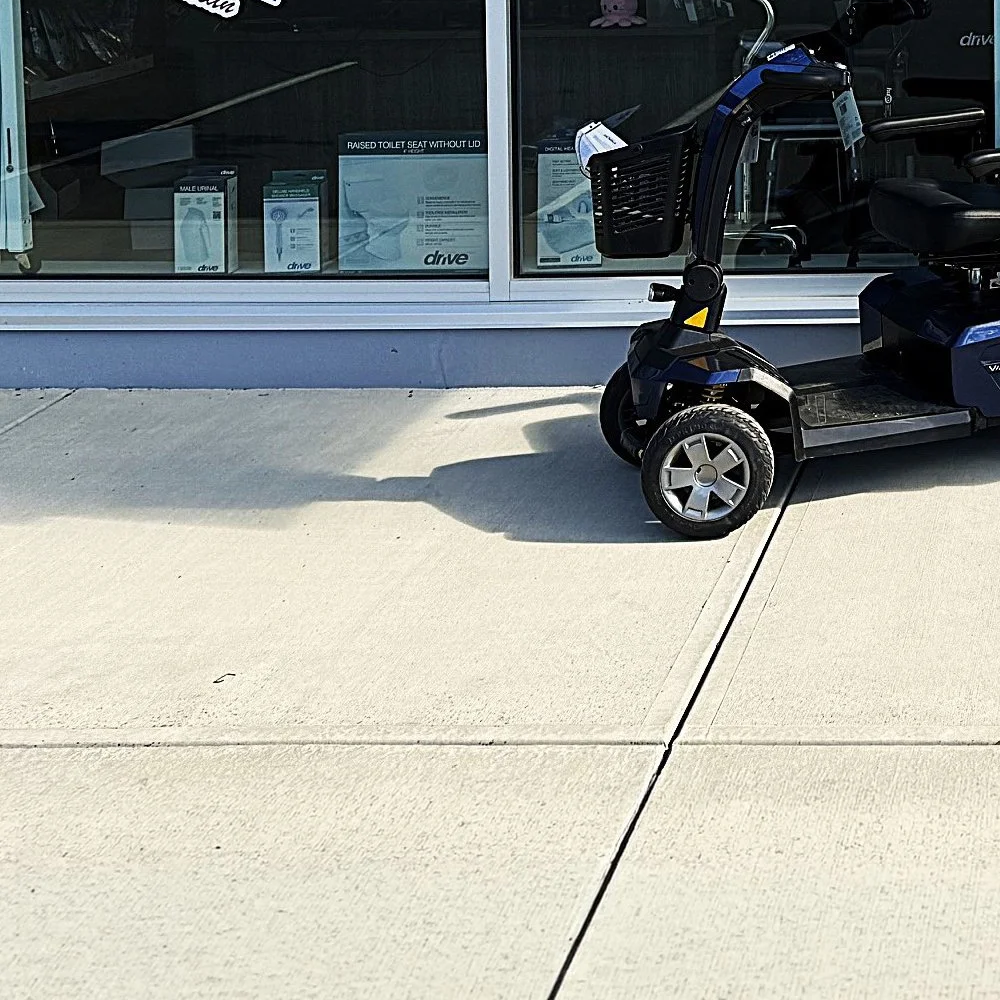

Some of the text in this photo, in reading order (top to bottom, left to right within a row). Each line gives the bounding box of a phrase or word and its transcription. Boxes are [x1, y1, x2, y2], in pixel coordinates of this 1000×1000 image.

[347, 140, 481, 149] RAISED TOILET SEAT WITHOUT LID
[423, 250, 469, 266] drive
[571, 254, 594, 263] drive
[197, 264, 219, 272] drive
[287, 262, 311, 270] drive
